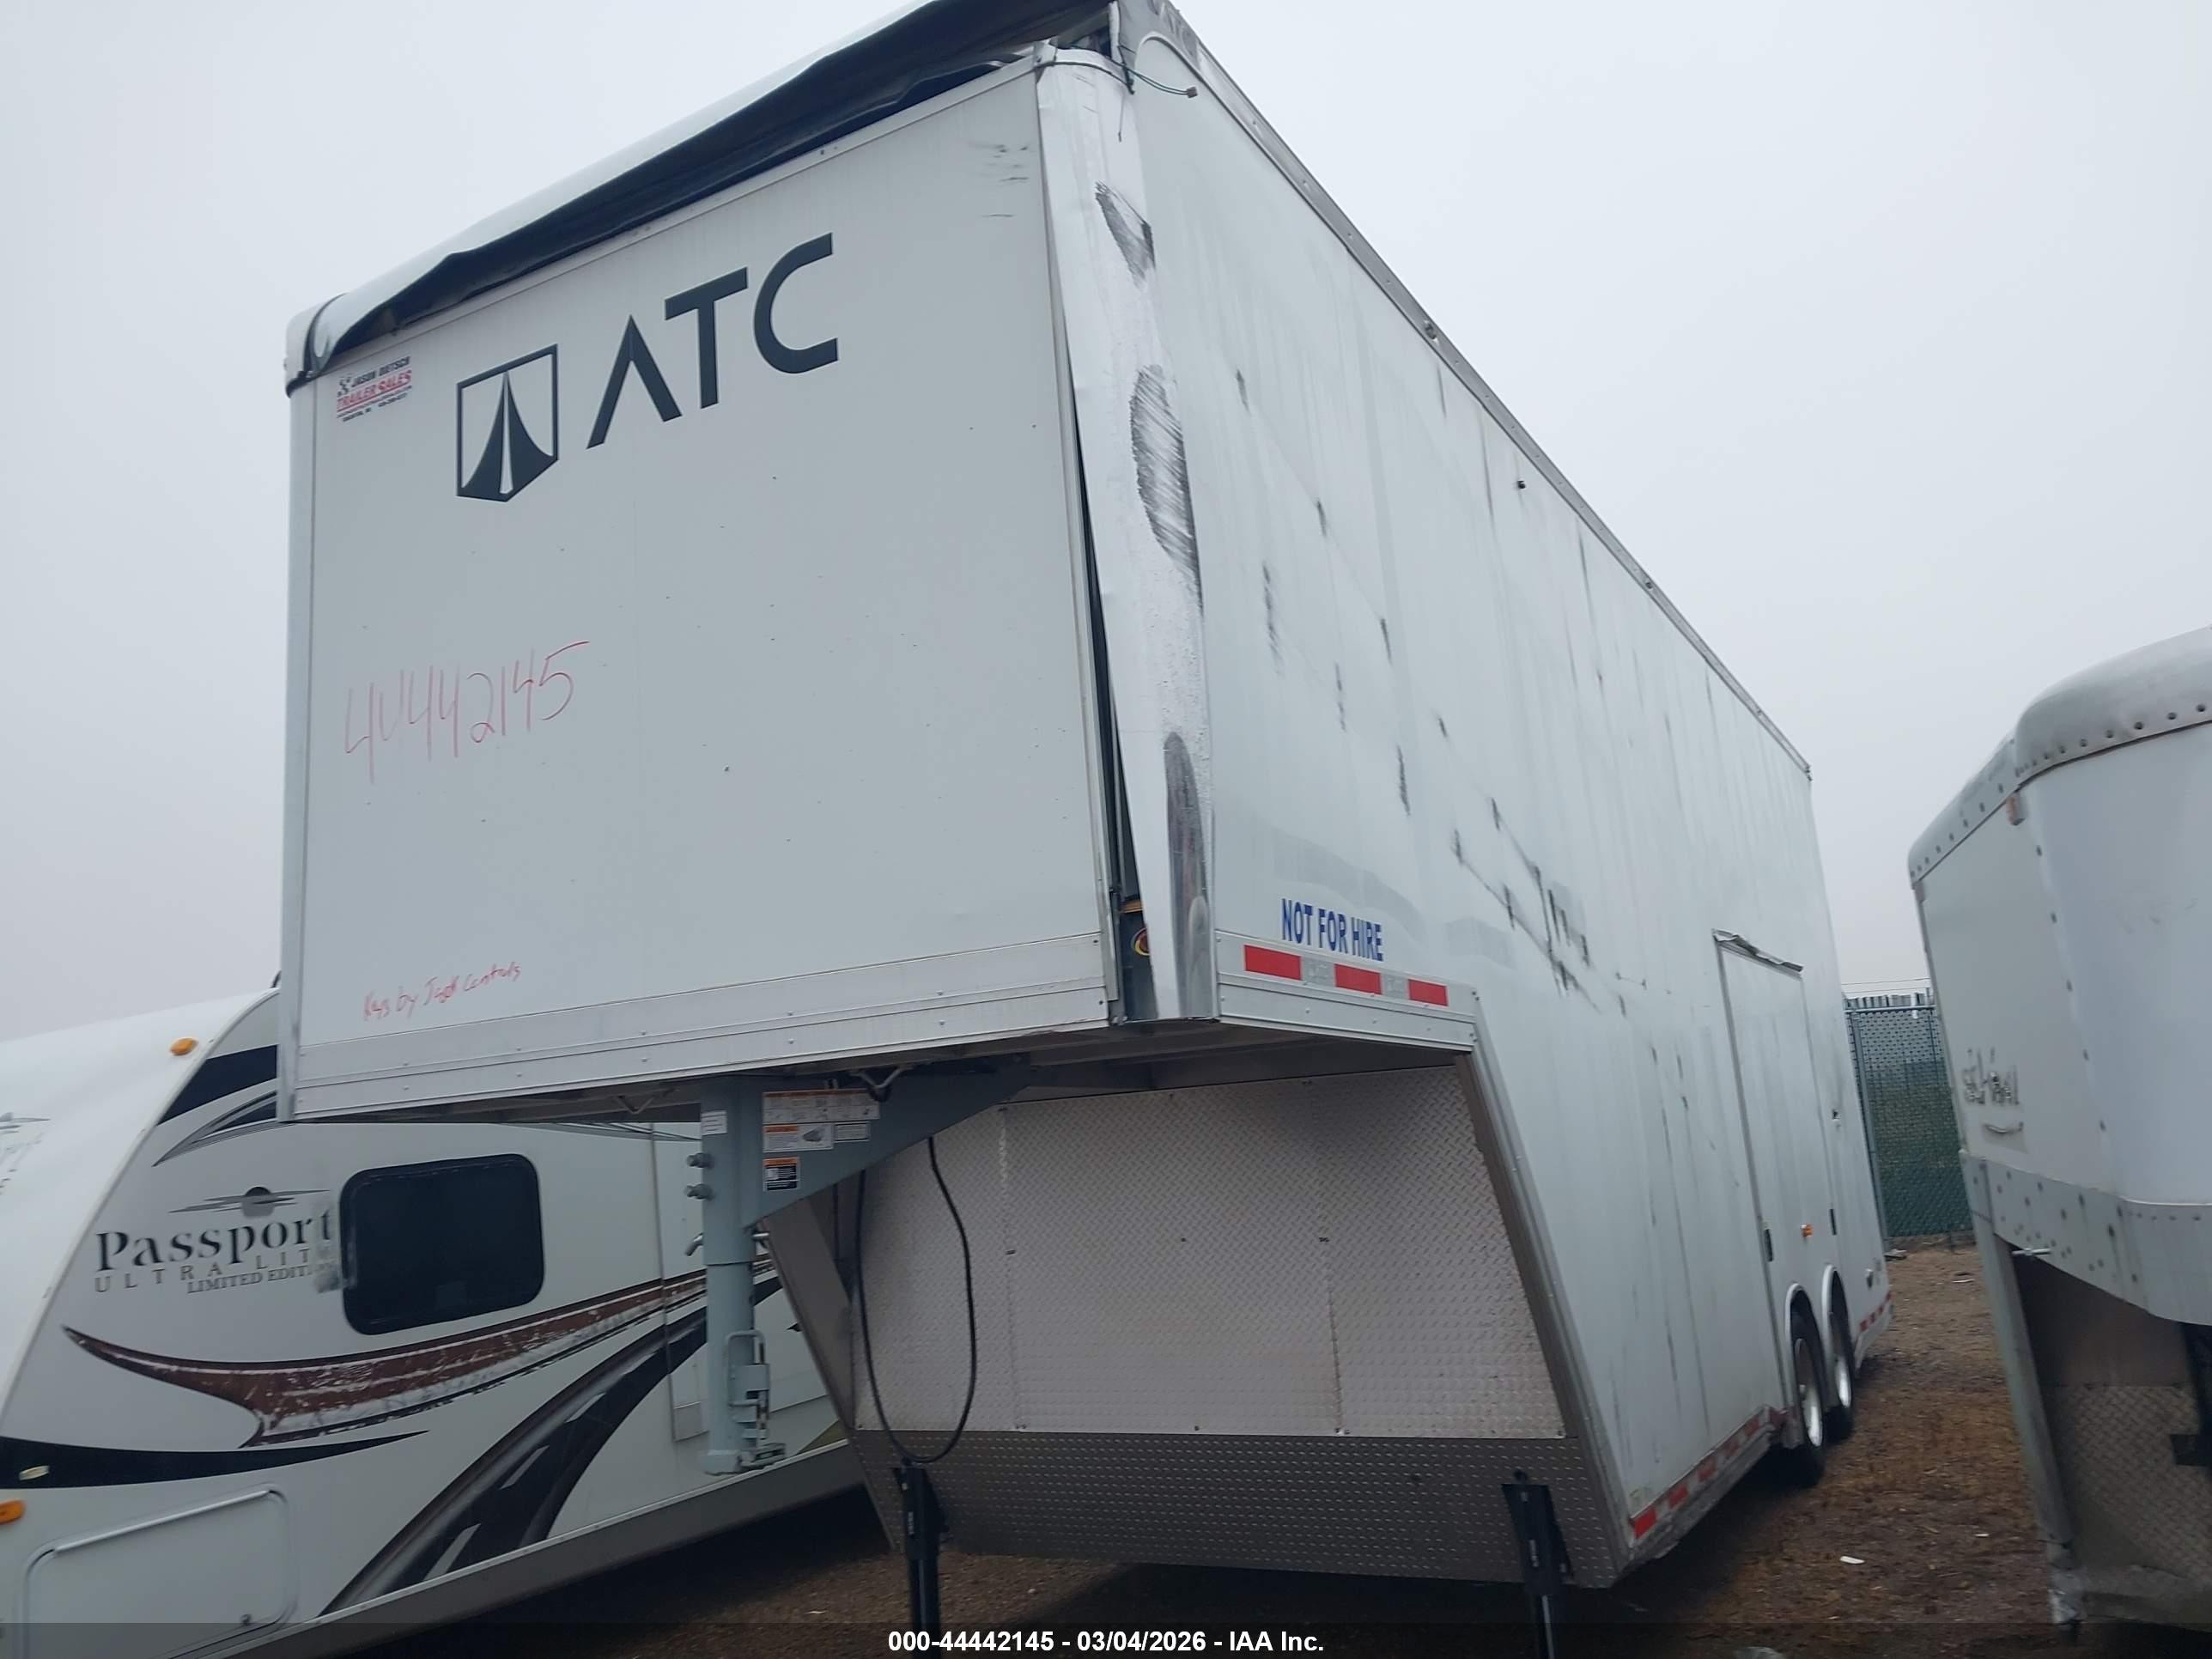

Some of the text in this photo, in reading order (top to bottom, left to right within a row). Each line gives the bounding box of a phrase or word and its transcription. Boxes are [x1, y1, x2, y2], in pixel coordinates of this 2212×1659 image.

[586, 232, 838, 449] ATC
[337, 383, 376, 410] TRAILER
[378, 369, 412, 391] SALES
[1282, 898, 1384, 962] NOT FOR HIRE
[95, 1208, 331, 1272] Passport
[94, 1261, 222, 1293] ULTRA
[186, 1272, 263, 1294] LIMITED
